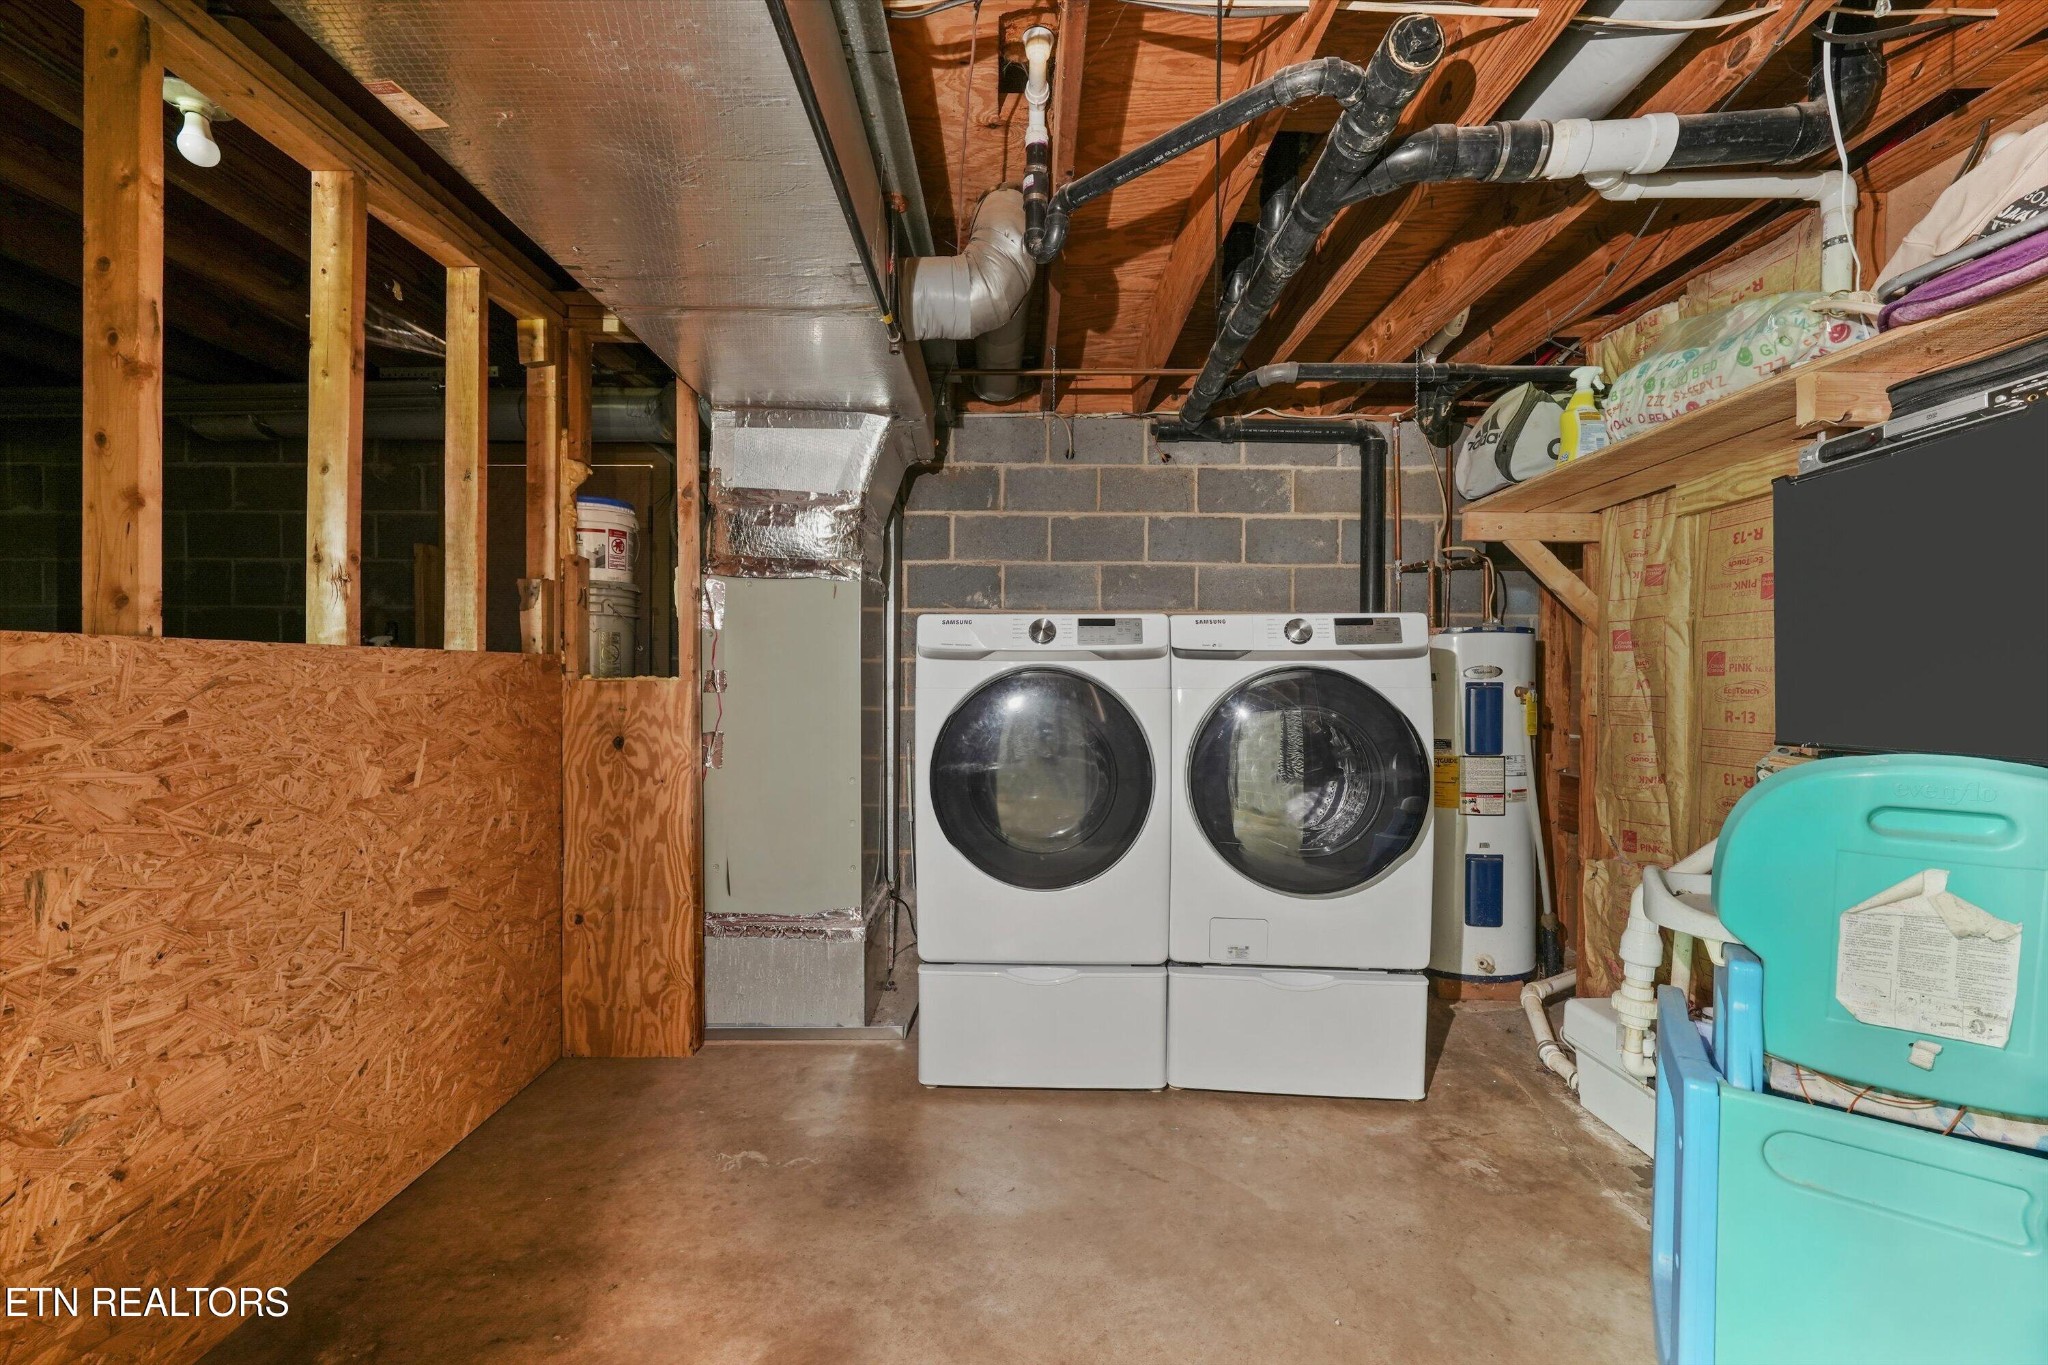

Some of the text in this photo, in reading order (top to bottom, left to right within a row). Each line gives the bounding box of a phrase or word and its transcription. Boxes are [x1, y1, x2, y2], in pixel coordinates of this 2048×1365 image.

[1733, 527, 1764, 545] R-13
[1734, 579, 1758, 591] PINK
[1728, 663, 1753, 673] PINK
[1723, 687, 1760, 695] EcoTouch
[1725, 710, 1756, 724] R-13
[1723, 772, 1755, 788] R-13
[1893, 781, 1998, 806] evenflo
[1640, 843, 1663, 854] PINK
